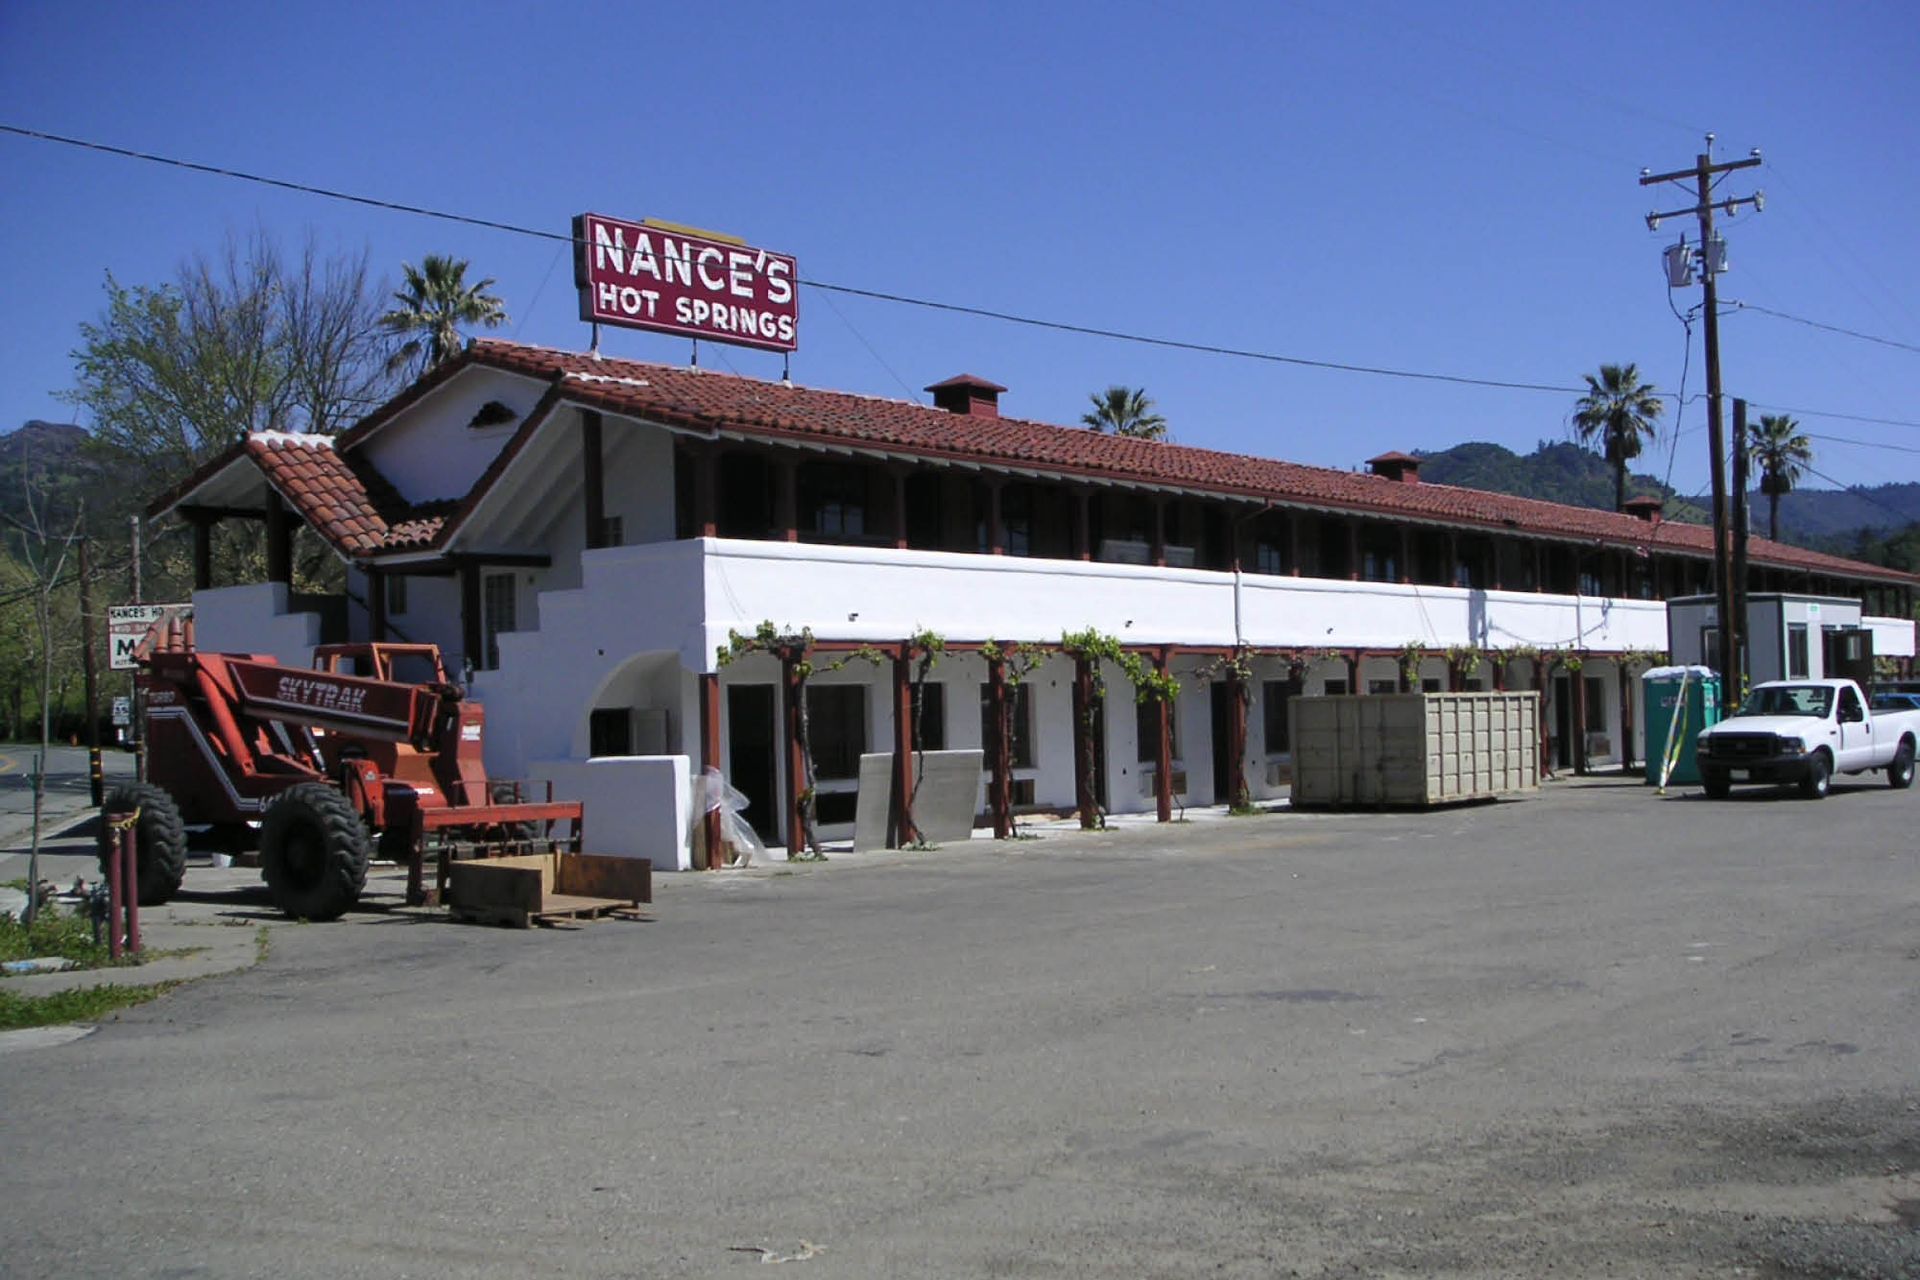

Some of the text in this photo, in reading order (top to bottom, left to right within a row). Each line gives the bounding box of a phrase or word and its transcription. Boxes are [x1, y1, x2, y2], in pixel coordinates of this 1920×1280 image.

[595, 223, 792, 304] NANCE'S
[598, 281, 793, 341] HOT SPRINGS
[278, 677, 367, 713] SKYTRAK
